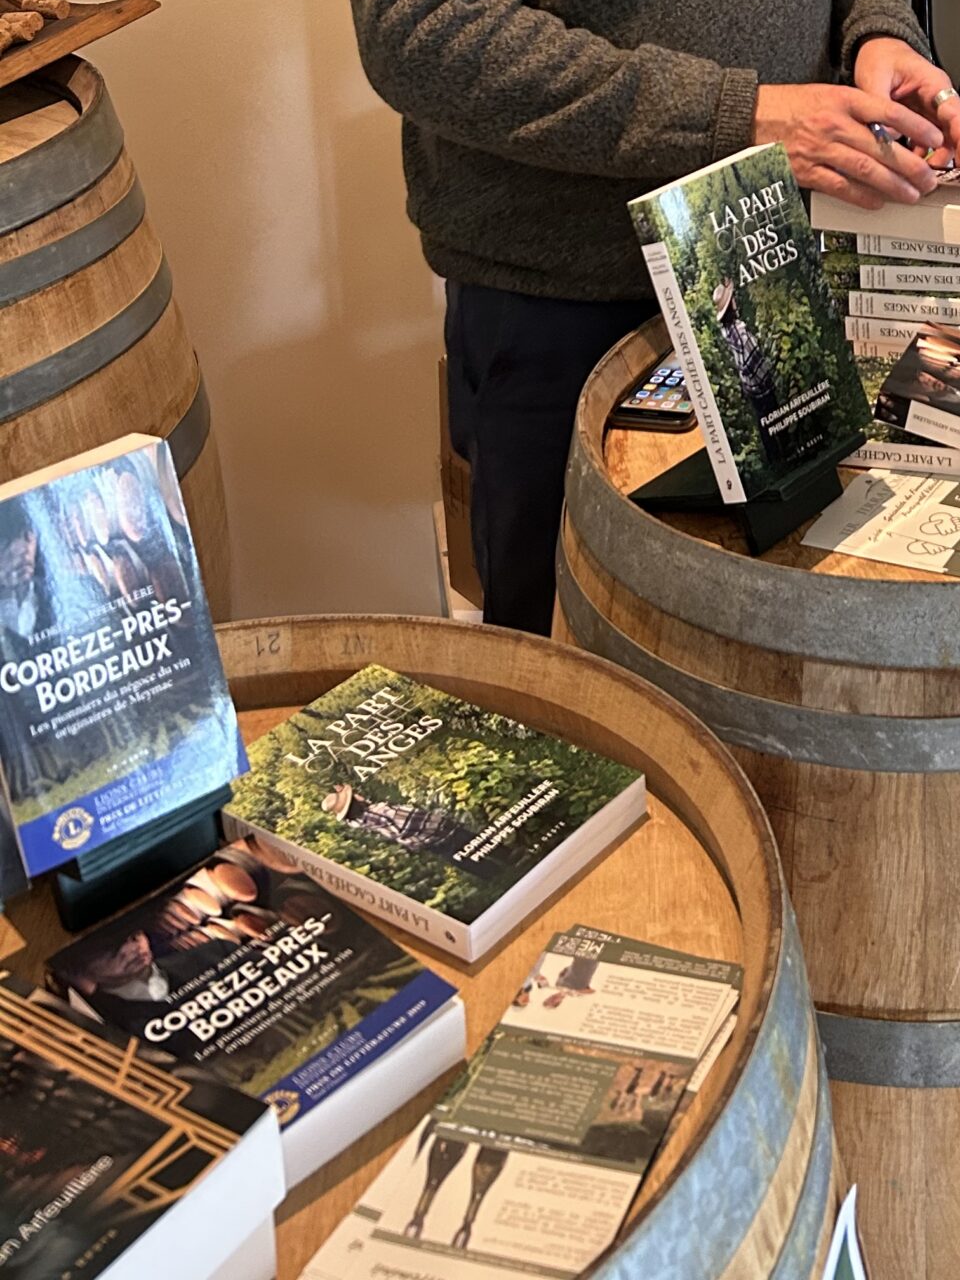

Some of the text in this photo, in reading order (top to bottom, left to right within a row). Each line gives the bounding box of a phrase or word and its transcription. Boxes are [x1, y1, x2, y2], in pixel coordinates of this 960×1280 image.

[709, 181, 785, 233] LA PART
[742, 224, 778, 257] DES
[891, 241, 923, 253] ANGES
[926, 243, 946, 254] DES
[739, 239, 798, 287] ANGES
[896, 273, 930, 284] ANGES
[934, 274, 953, 284] DES
[883, 302, 917, 314] ANGES
[920, 305, 939, 316] DES
[879, 328, 913, 340] ANGES
[662, 286, 727, 465] LA PART CACHÉE DES ANGES
[760, 404, 789, 427] FLORIAN
[768, 392, 830, 436] PHILIPPE SOUBIRAN
[853, 445, 953, 468] LA PART CACHÉE
[0, 597, 192, 694] CORRÈZE-PRÈS-
[36, 634, 172, 713] BORDEAUX
[29, 657, 191, 737] Les pionniers du négoce du vin
[54, 678, 174, 740] originaires de Meymac
[284, 686, 402, 769] LA PART
[349, 716, 406, 758] DES
[352, 715, 445, 783] ANGES
[453, 824, 494, 862] FLORIAN
[470, 788, 561, 863] PHILIPPE SOUBIRAN
[380, 896, 412, 925] PART
[411, 911, 430, 932] LA
[144, 912, 333, 1042] CORRÈZE-PRÈS-
[187, 943, 329, 1042] BORDEAUX
[266, 995, 283, 1014] du
[319, 960, 336, 980] du
[282, 999, 299, 1018] de
